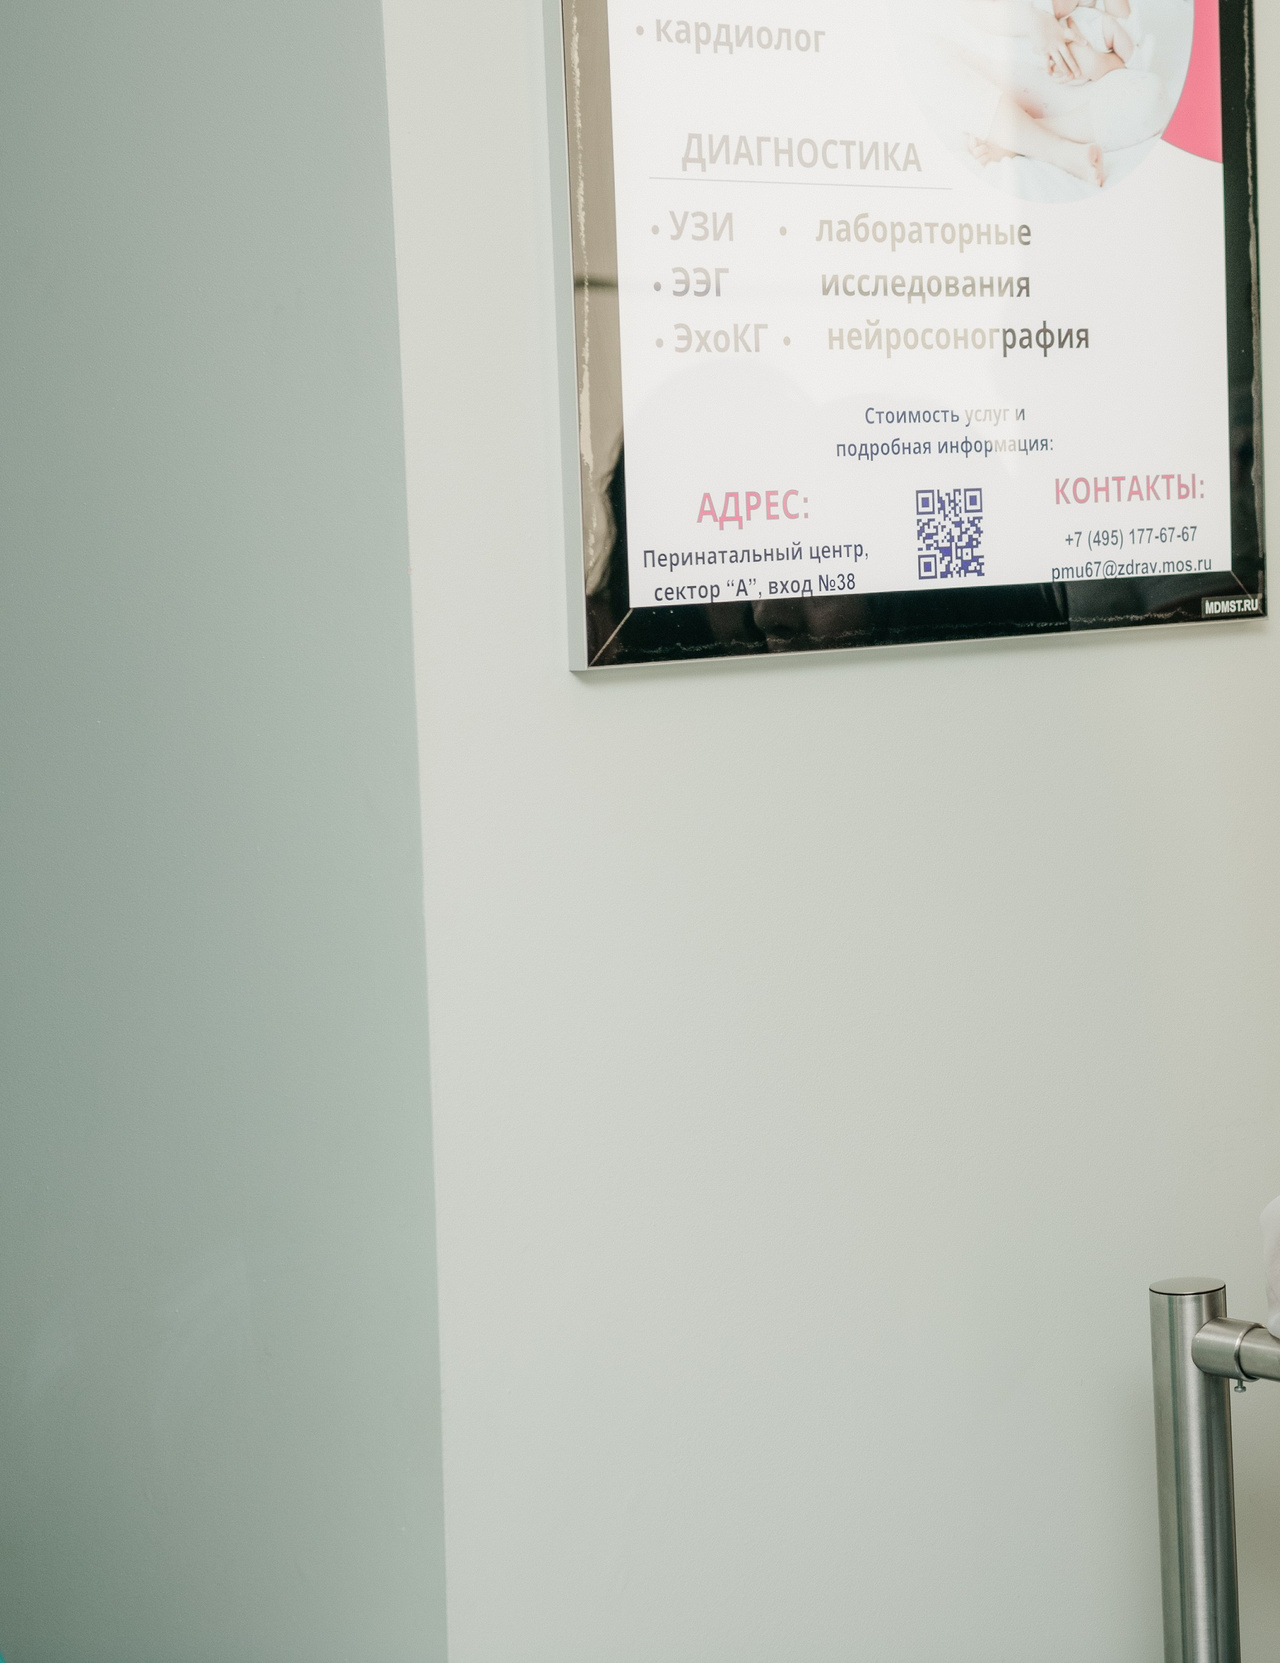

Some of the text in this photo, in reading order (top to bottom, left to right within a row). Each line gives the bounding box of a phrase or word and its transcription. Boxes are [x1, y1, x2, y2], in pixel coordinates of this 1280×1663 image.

[655, 18, 826, 55] кардиолог
[681, 132, 923, 173] ДИАГНОСТИКА
[668, 210, 734, 242] УЗИ
[815, 212, 1032, 254] лабораторные
[671, 266, 730, 297] ЭЭГ
[821, 273, 1031, 305] исследования
[673, 322, 769, 353] ЭхоКГ
[828, 318, 1090, 358] нейросонография
[864, 407, 1026, 427] Стоимость услуг и
[836, 436, 1054, 461] подробная информация:
[1055, 473, 1205, 505] КОНТАКТЫ:
[696, 489, 809, 531] АДРЕС:
[1065, 526, 1198, 551] +7 (495) 177-67-67
[643, 541, 869, 572] Перинатальный центр,
[1051, 558, 1212, 582] pmu67@zdrav.mos.ru
[654, 583, 720, 603] сектор
[768, 578, 813, 597] вход
[818, 573, 856, 592] №38
[1205, 598, 1258, 614] MDMST.RU
